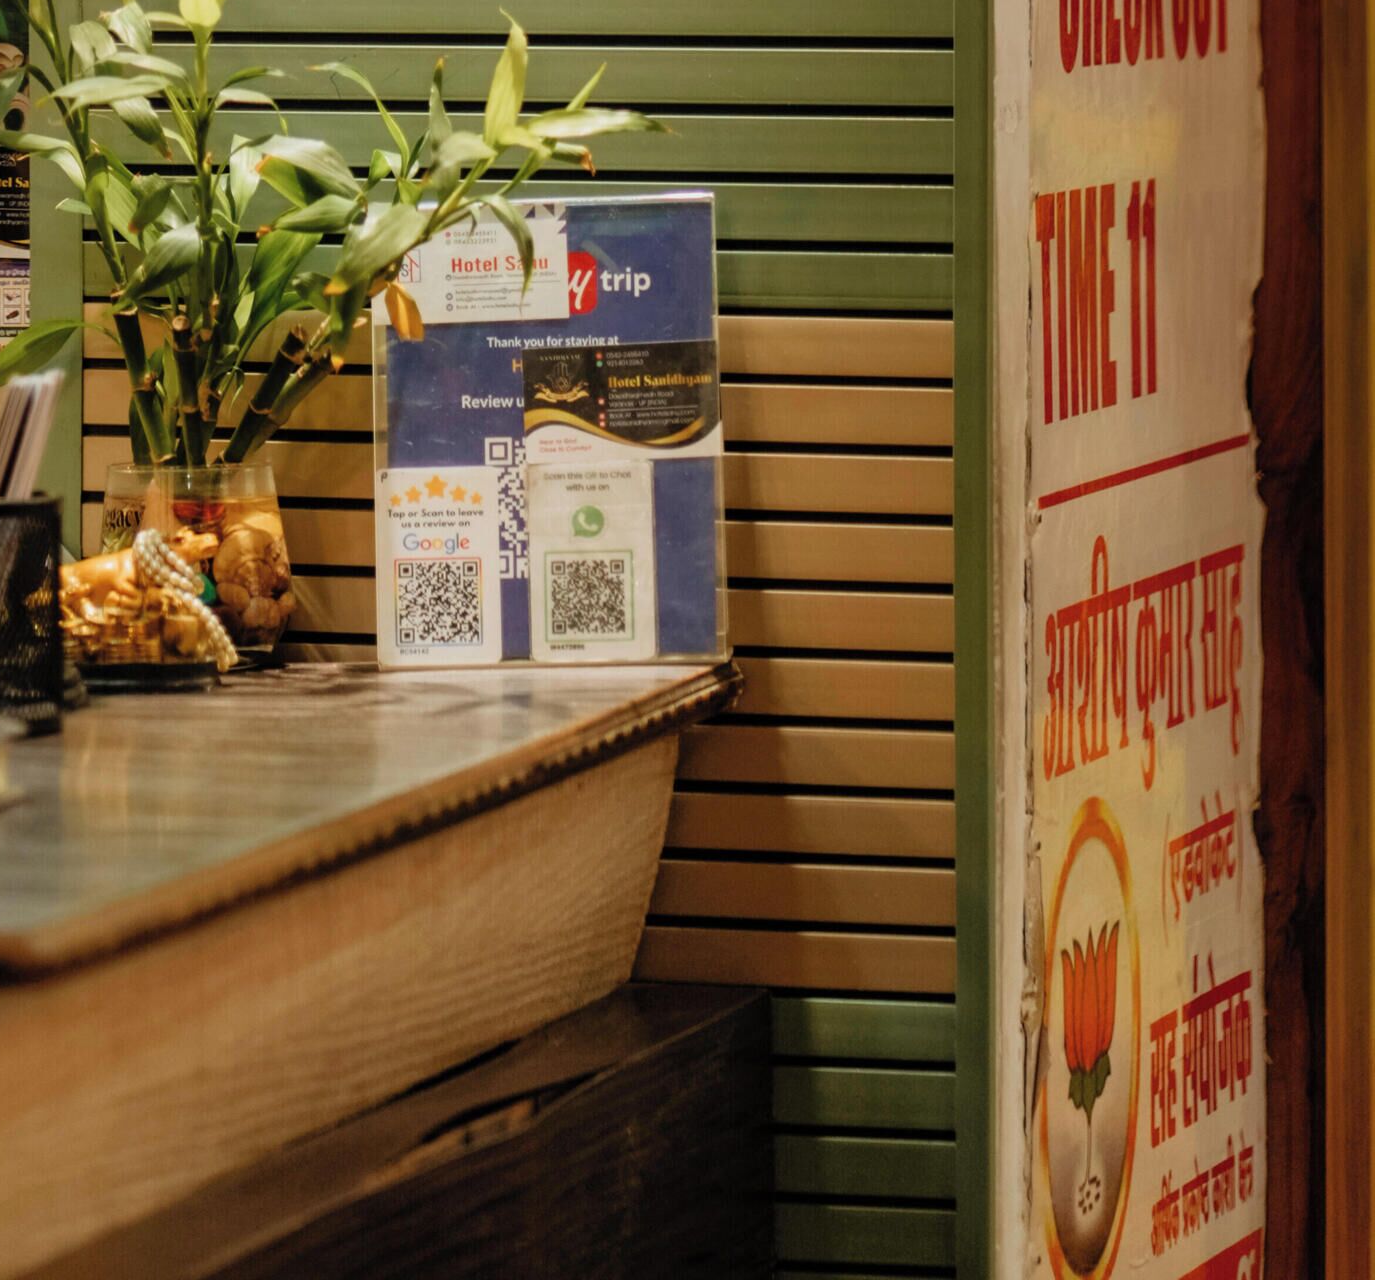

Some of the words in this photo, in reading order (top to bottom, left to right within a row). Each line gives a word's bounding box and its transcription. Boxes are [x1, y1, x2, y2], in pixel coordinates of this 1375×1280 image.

[451, 256, 498, 273] Hotel
[600, 266, 652, 298] trip
[1035, 183, 1117, 426] TIME
[486, 336, 522, 348] Thank
[523, 338, 545, 350] you
[546, 335, 564, 347] for
[565, 335, 606, 347] staying
[607, 335, 619, 346] at
[461, 394, 514, 409] Review
[567, 471, 583, 480] this
[566, 483, 585, 492] with
[388, 509, 406, 521] Tap
[408, 510, 418, 518] or
[421, 509, 444, 517] Scan
[446, 509, 456, 517] to
[458, 508, 484, 517] leave
[401, 521, 412, 529] us
[423, 520, 456, 528] review
[402, 532, 470, 555] Google
[1133, 561, 1196, 792] कुमार
